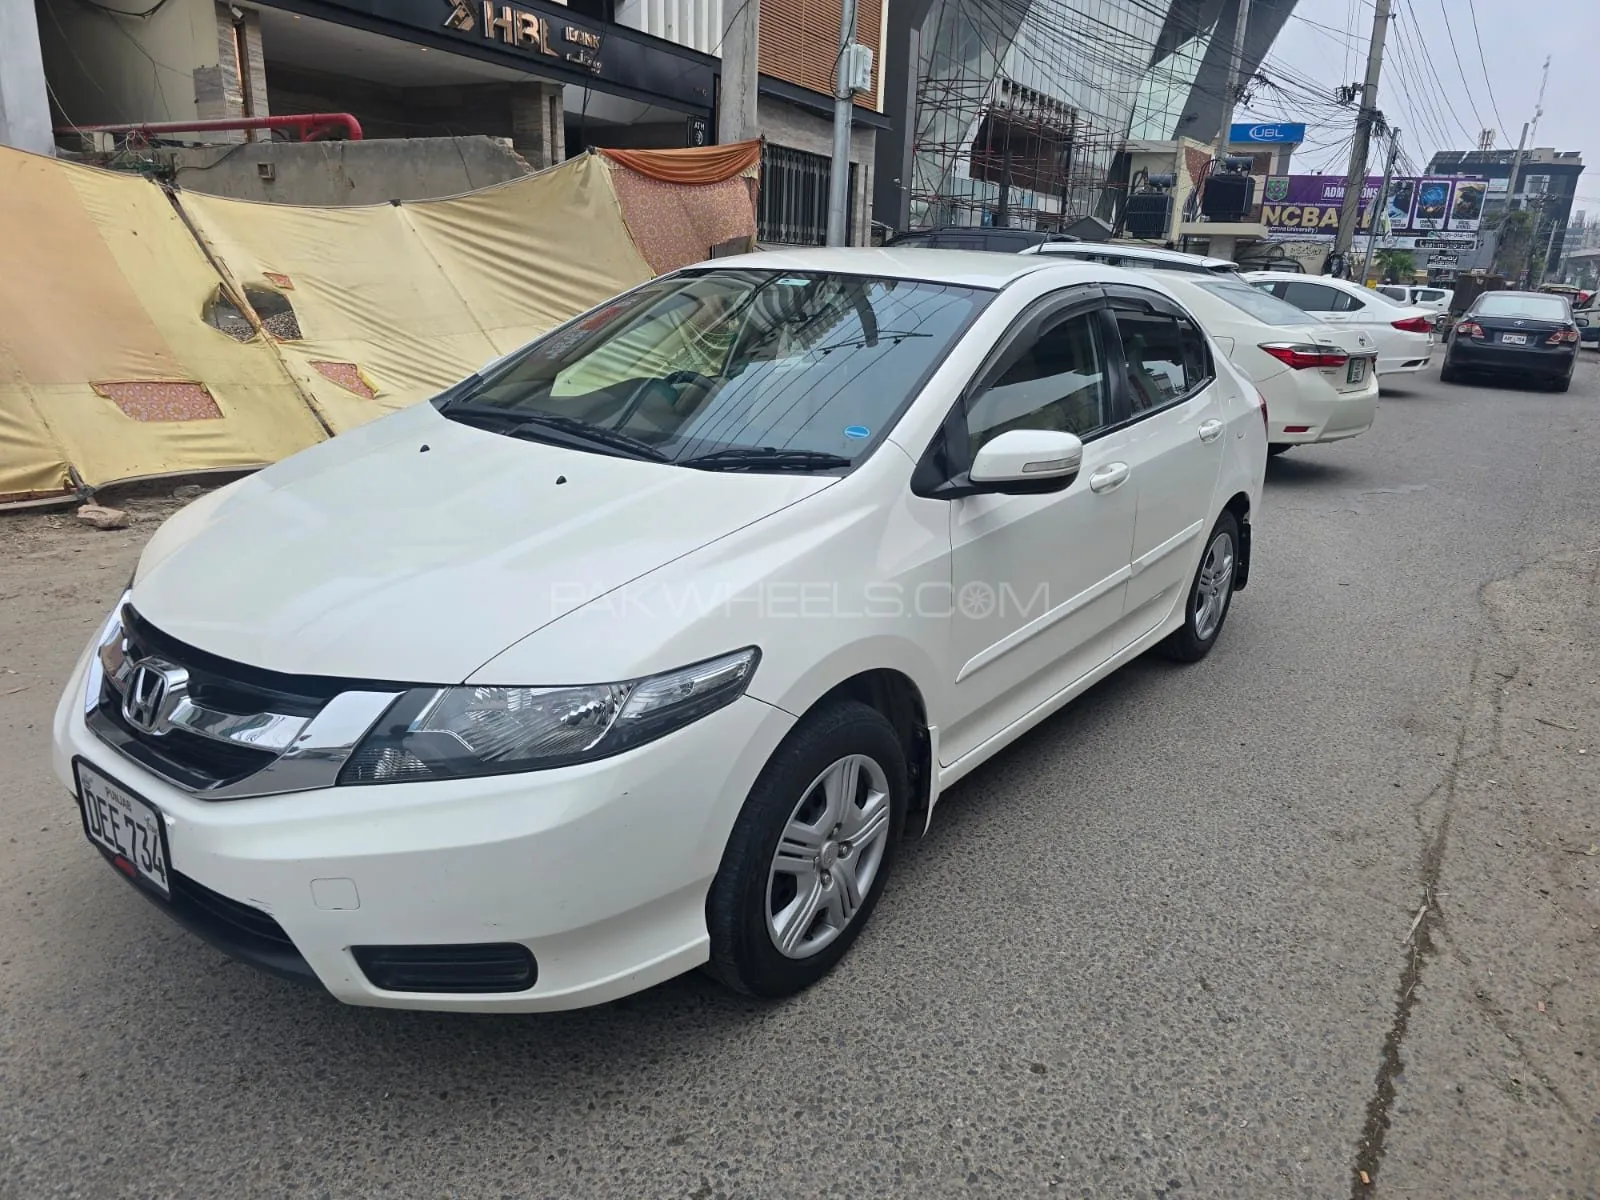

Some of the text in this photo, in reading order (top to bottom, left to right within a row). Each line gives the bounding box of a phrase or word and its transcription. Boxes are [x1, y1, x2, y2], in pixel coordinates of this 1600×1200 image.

[483, 1, 559, 57] HBL
[693, 121, 705, 131] ATM
[1254, 128, 1284, 138] UBL
